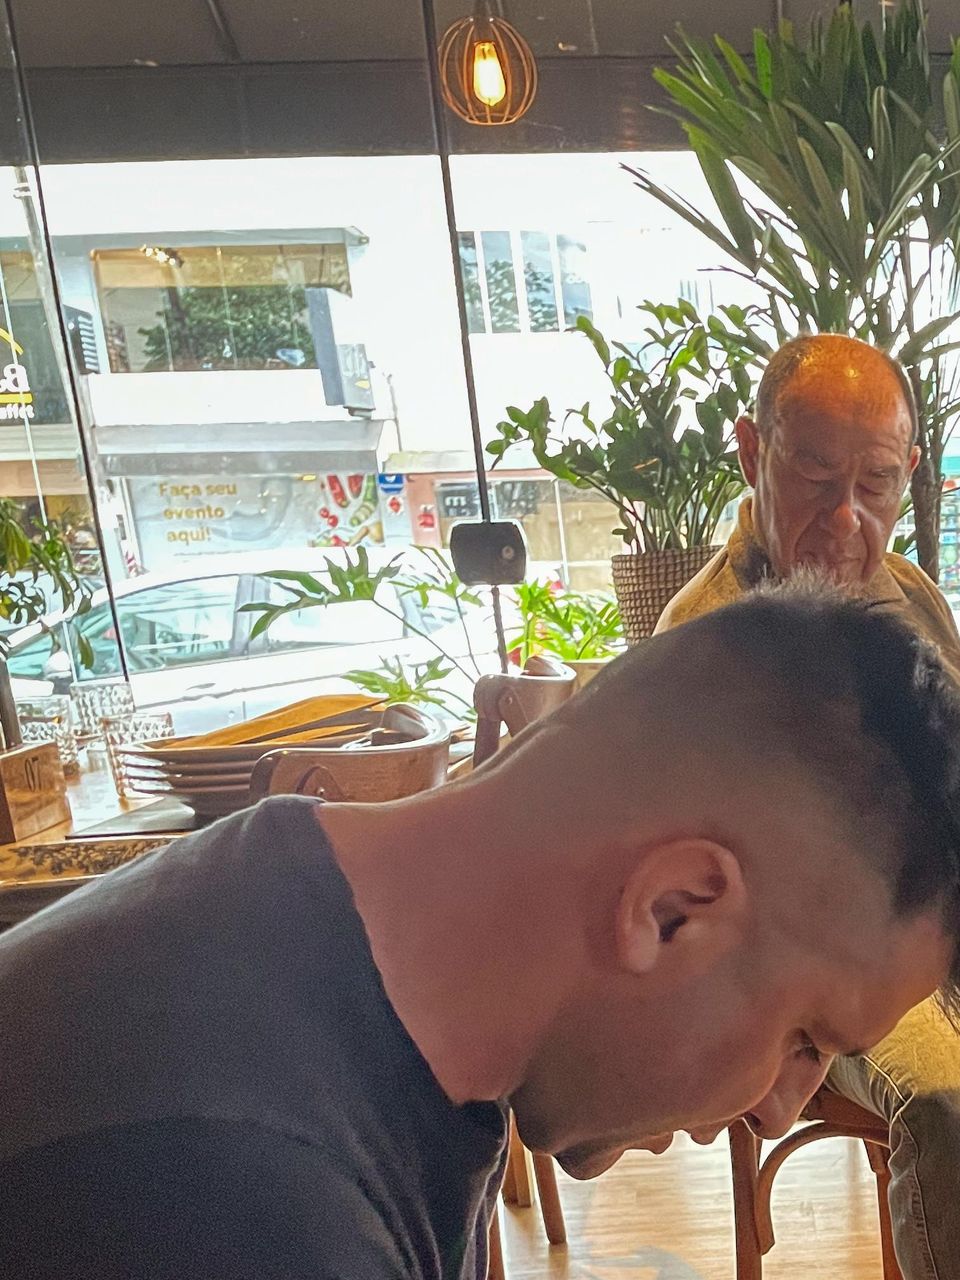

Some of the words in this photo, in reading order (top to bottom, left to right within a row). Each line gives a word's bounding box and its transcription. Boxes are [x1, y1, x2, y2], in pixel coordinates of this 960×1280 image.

[159, 483, 202, 500] Faça
[206, 483, 237, 496] seu
[163, 504, 224, 520] evento
[167, 526, 211, 546] aqui!
